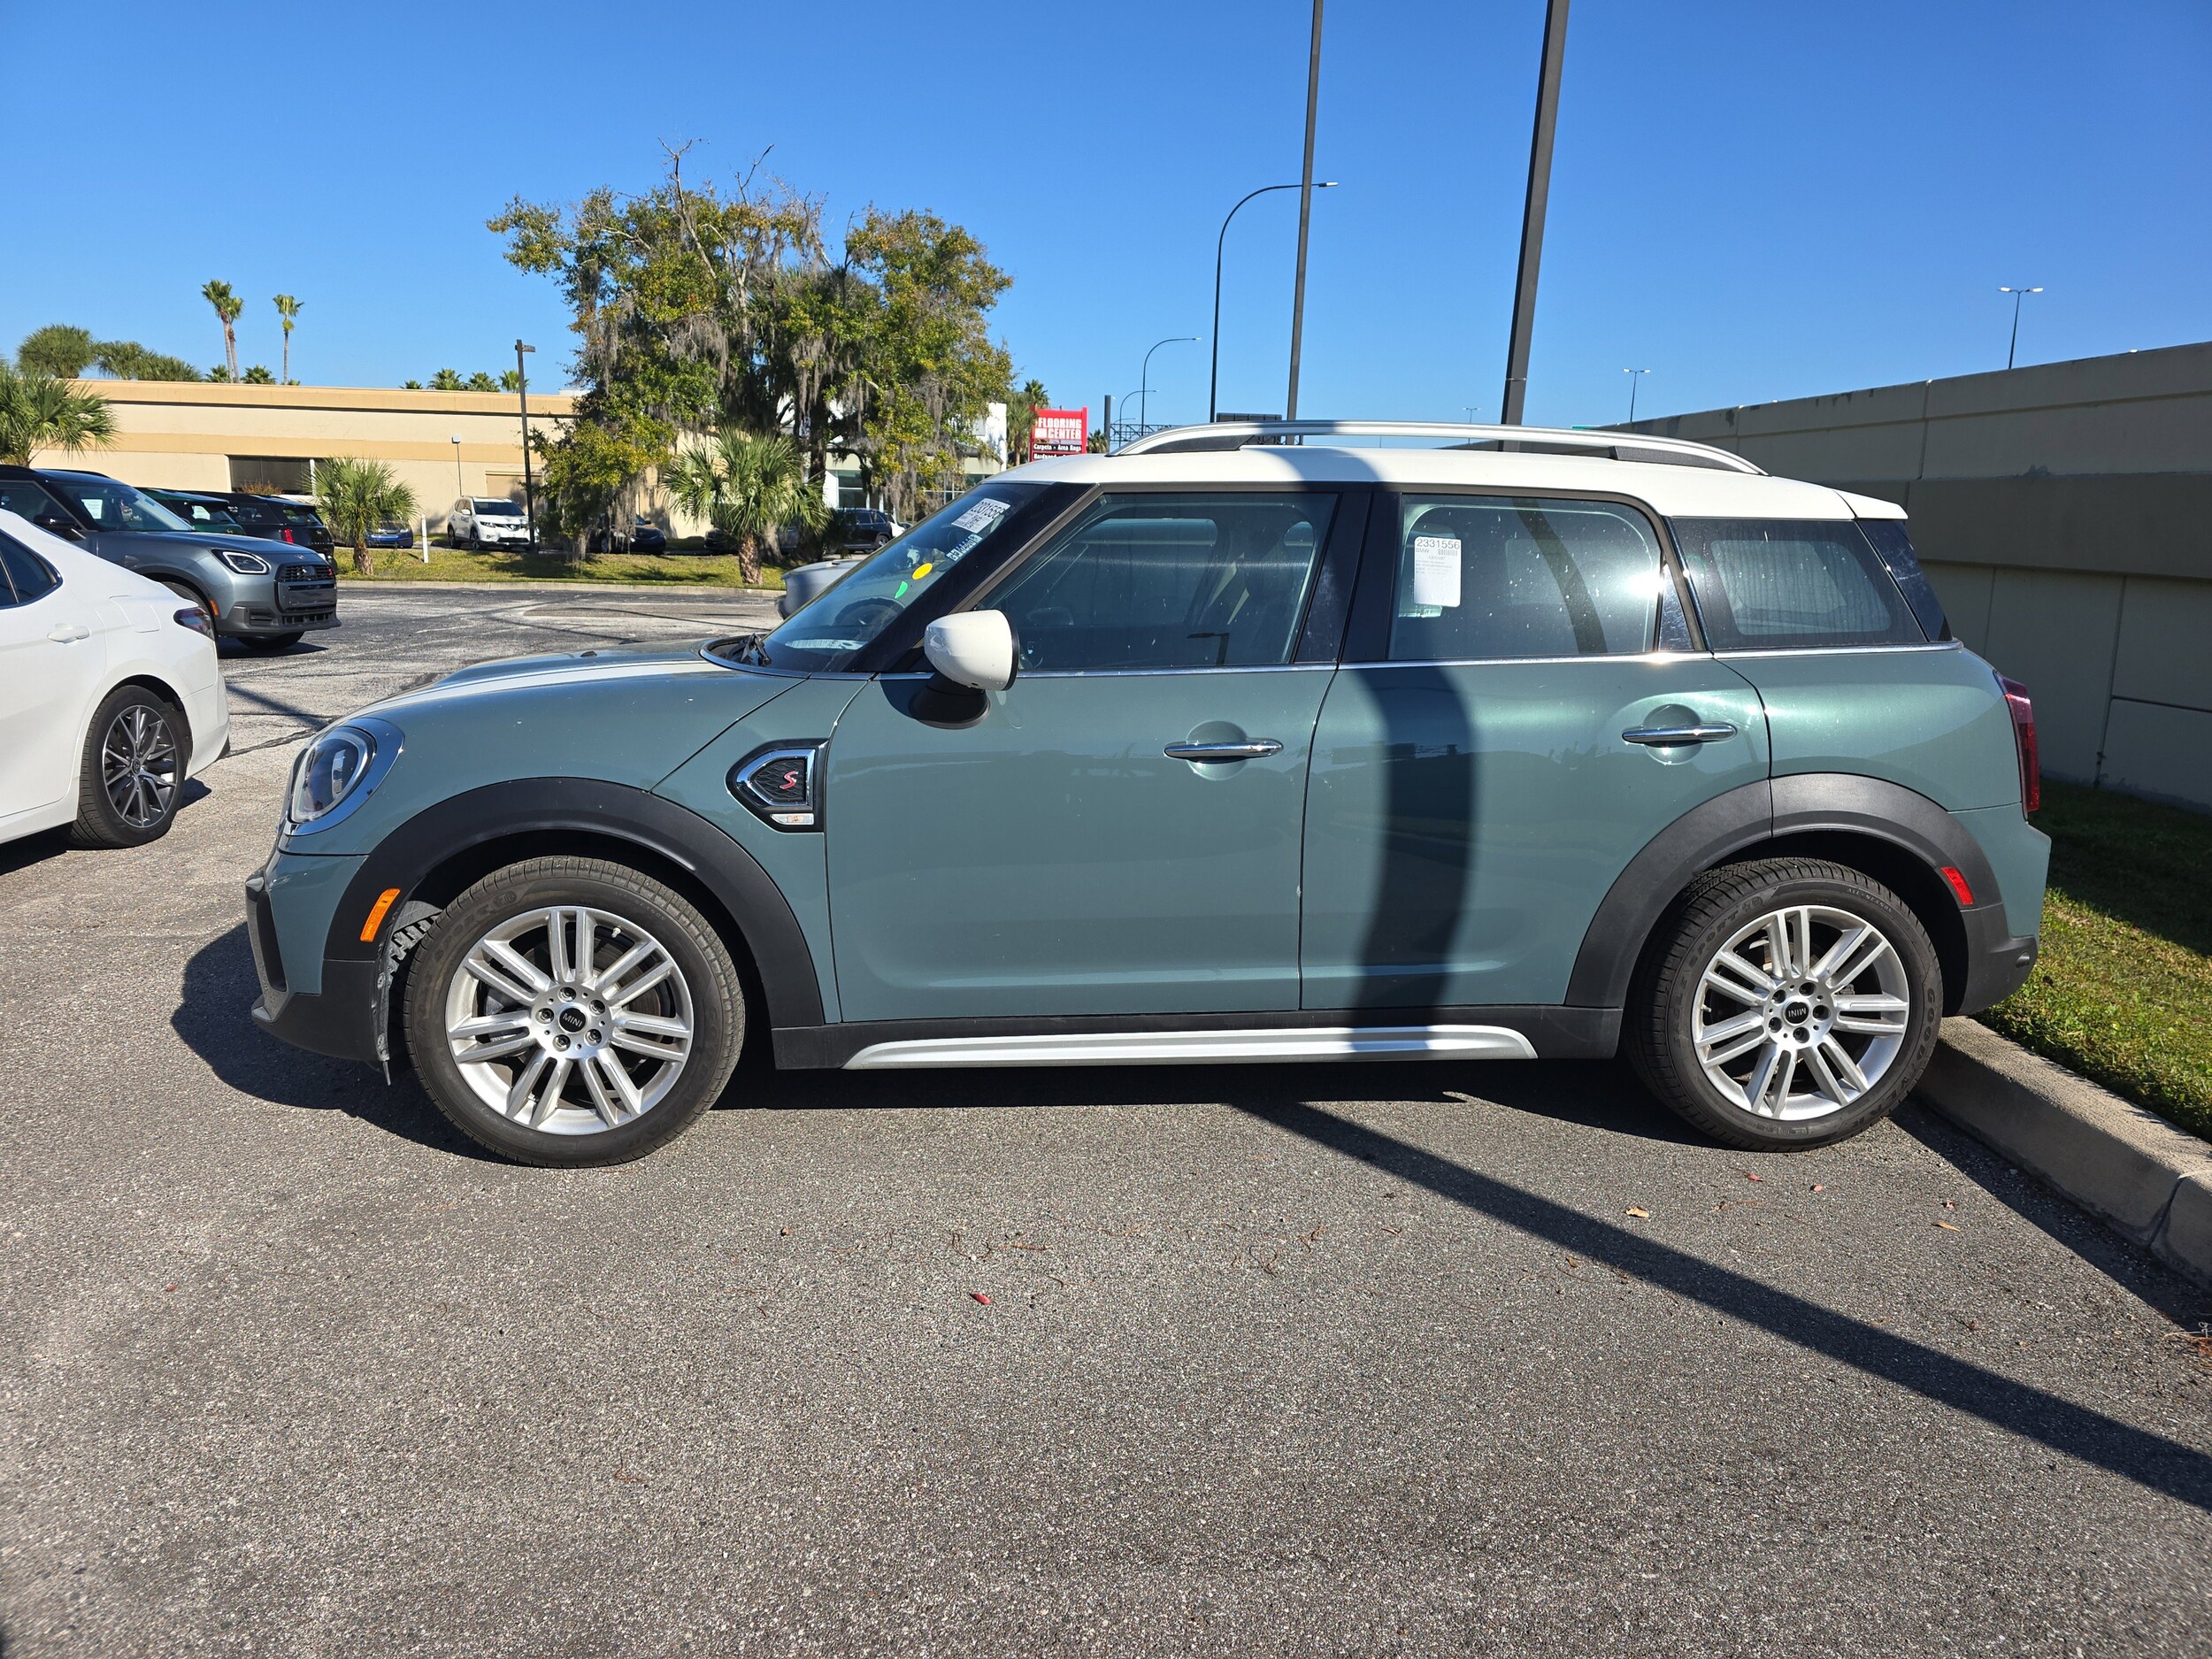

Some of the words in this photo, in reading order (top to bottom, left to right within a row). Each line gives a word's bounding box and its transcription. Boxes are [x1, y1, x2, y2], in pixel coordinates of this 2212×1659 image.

[1038, 417, 1082, 428] FLOORING
[1048, 428, 1082, 440] CENTER
[1417, 539, 1460, 549] 2331556
[779, 770, 799, 790] S
[1788, 1007, 1807, 1018] MINI
[563, 1012, 583, 1027] MINI
